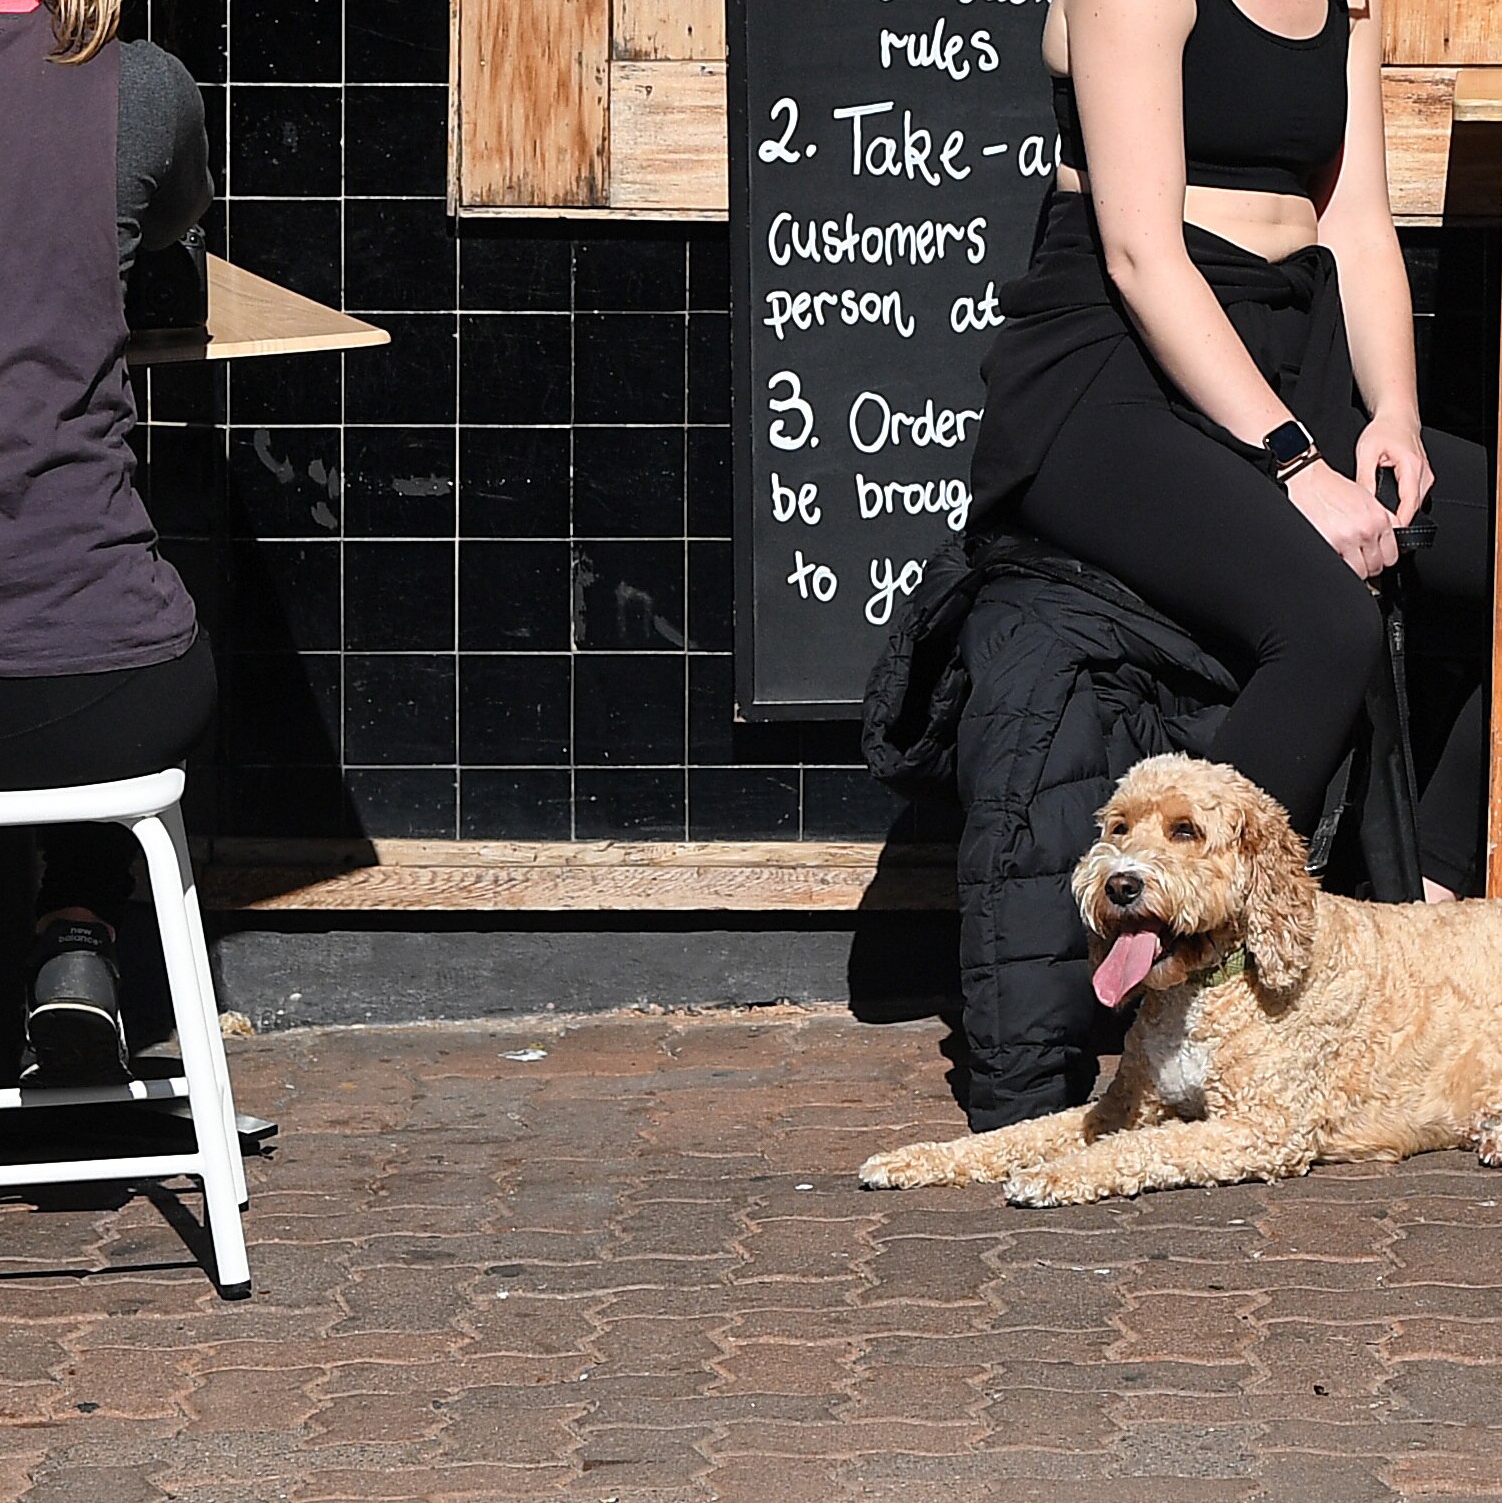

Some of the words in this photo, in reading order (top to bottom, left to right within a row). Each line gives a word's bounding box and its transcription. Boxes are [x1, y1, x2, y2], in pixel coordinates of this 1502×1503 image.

[880, 17, 999, 81] rules
[758, 97, 818, 163] 2.
[763, 289, 915, 340] person
[950, 281, 1006, 333] at
[768, 370, 820, 451] 3.
[770, 472, 821, 526] be
[787, 550, 838, 602] to
[57, 933, 101, 947] balance
[69, 926, 93, 936] new
